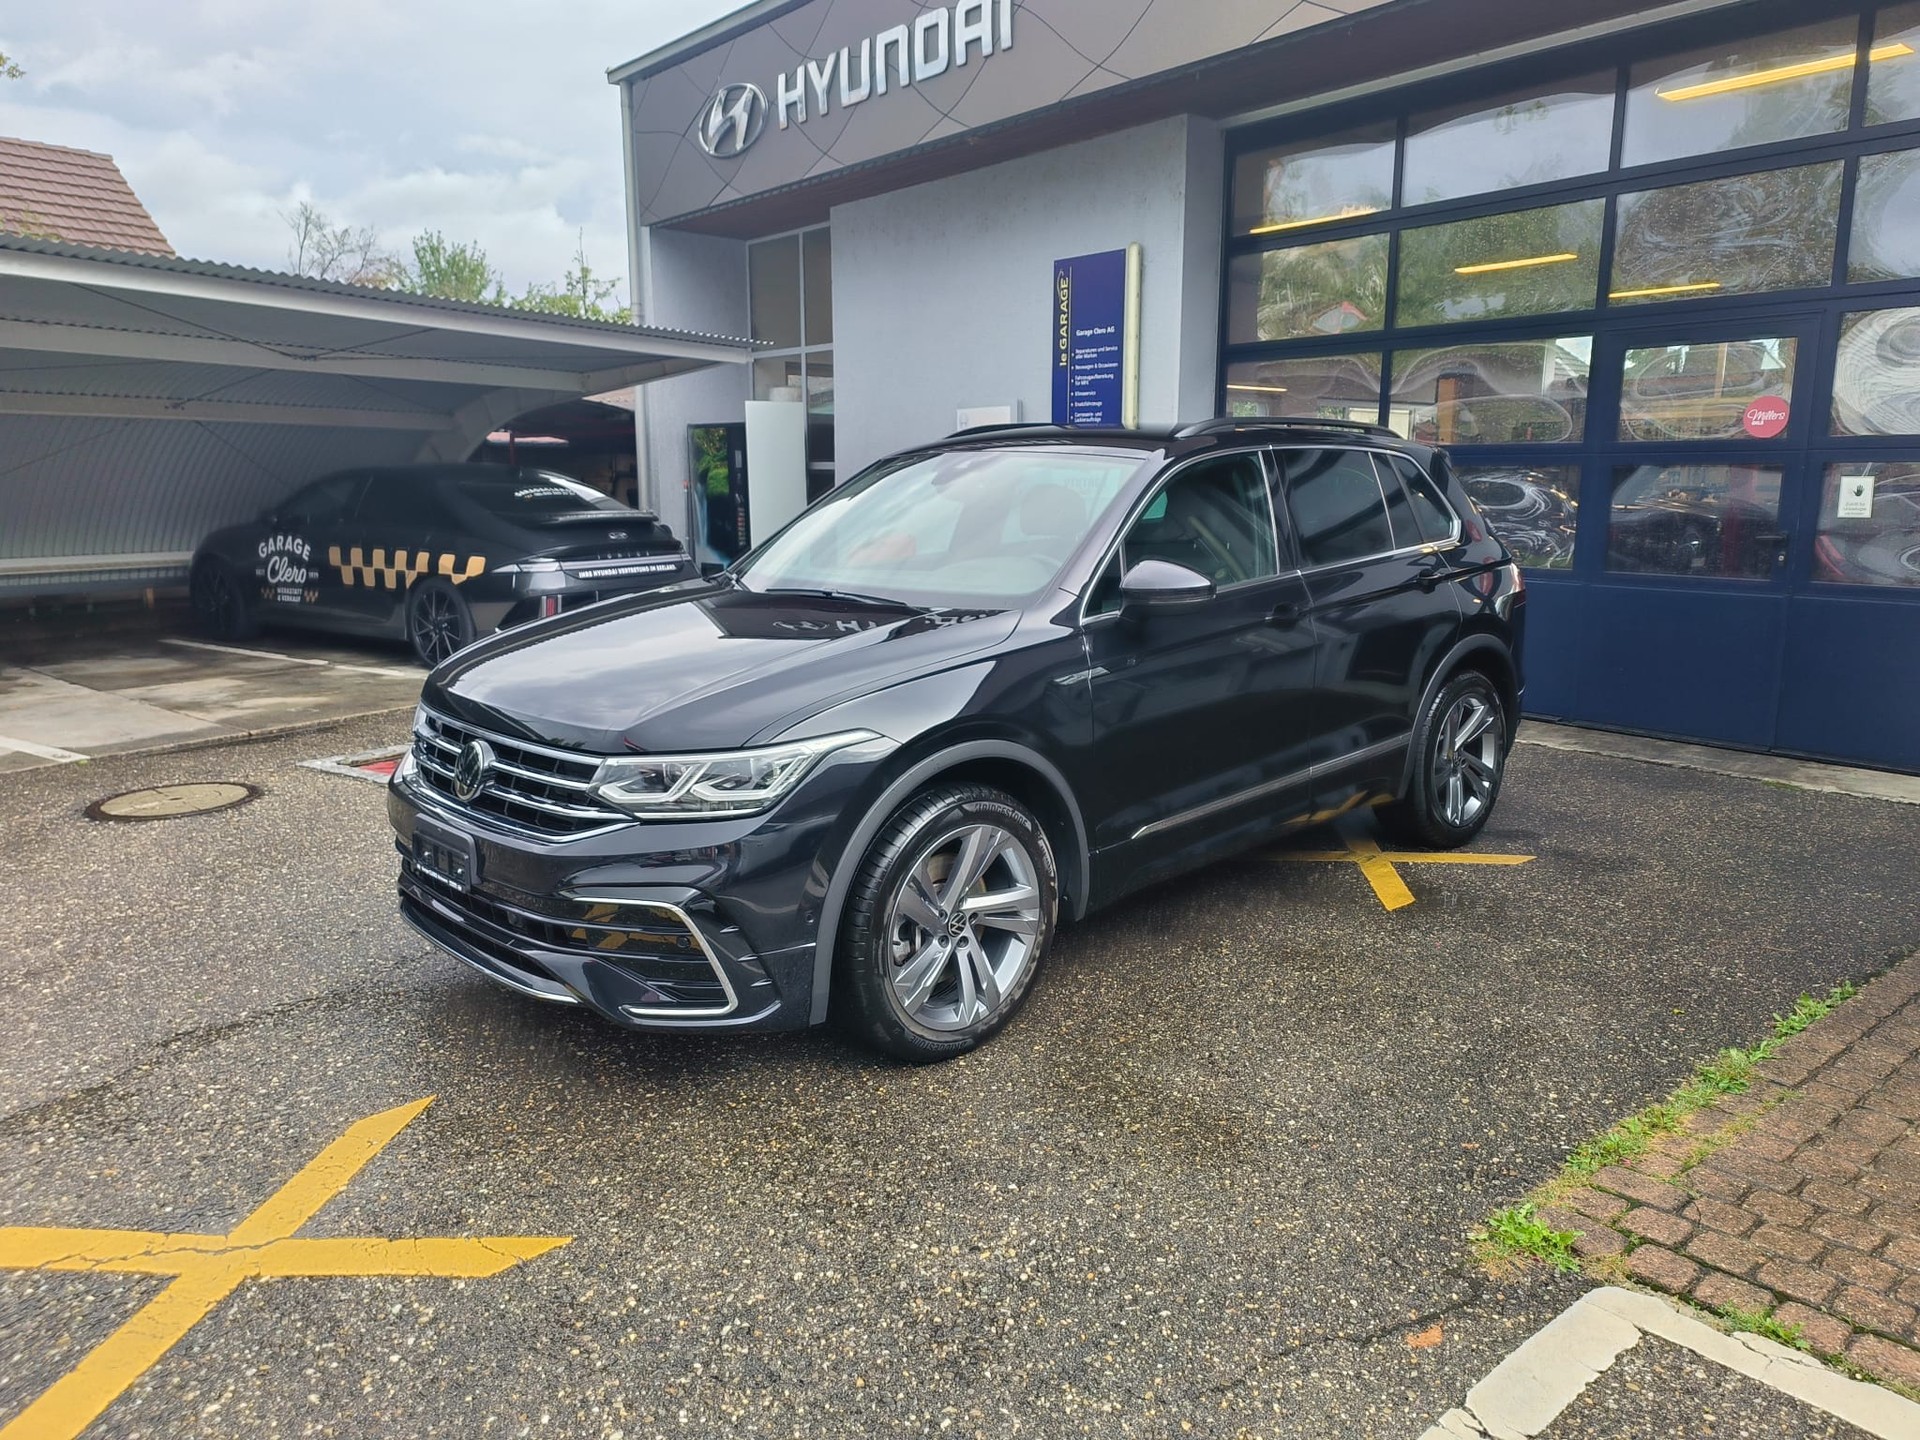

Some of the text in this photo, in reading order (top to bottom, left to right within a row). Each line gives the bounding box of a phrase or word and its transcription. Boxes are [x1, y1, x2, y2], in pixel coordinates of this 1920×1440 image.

[777, 0, 1012, 130] HYUNDAI
[1059, 277, 1069, 366] le GARAGE
[1075, 329, 1093, 337] Garage
[1107, 325, 1115, 333] AG
[1747, 408, 1785, 421] Millers
[258, 535, 311, 562] GARAGE
[267, 555, 307, 584] Clero
[593, 568, 618, 577] HYUNDAI
